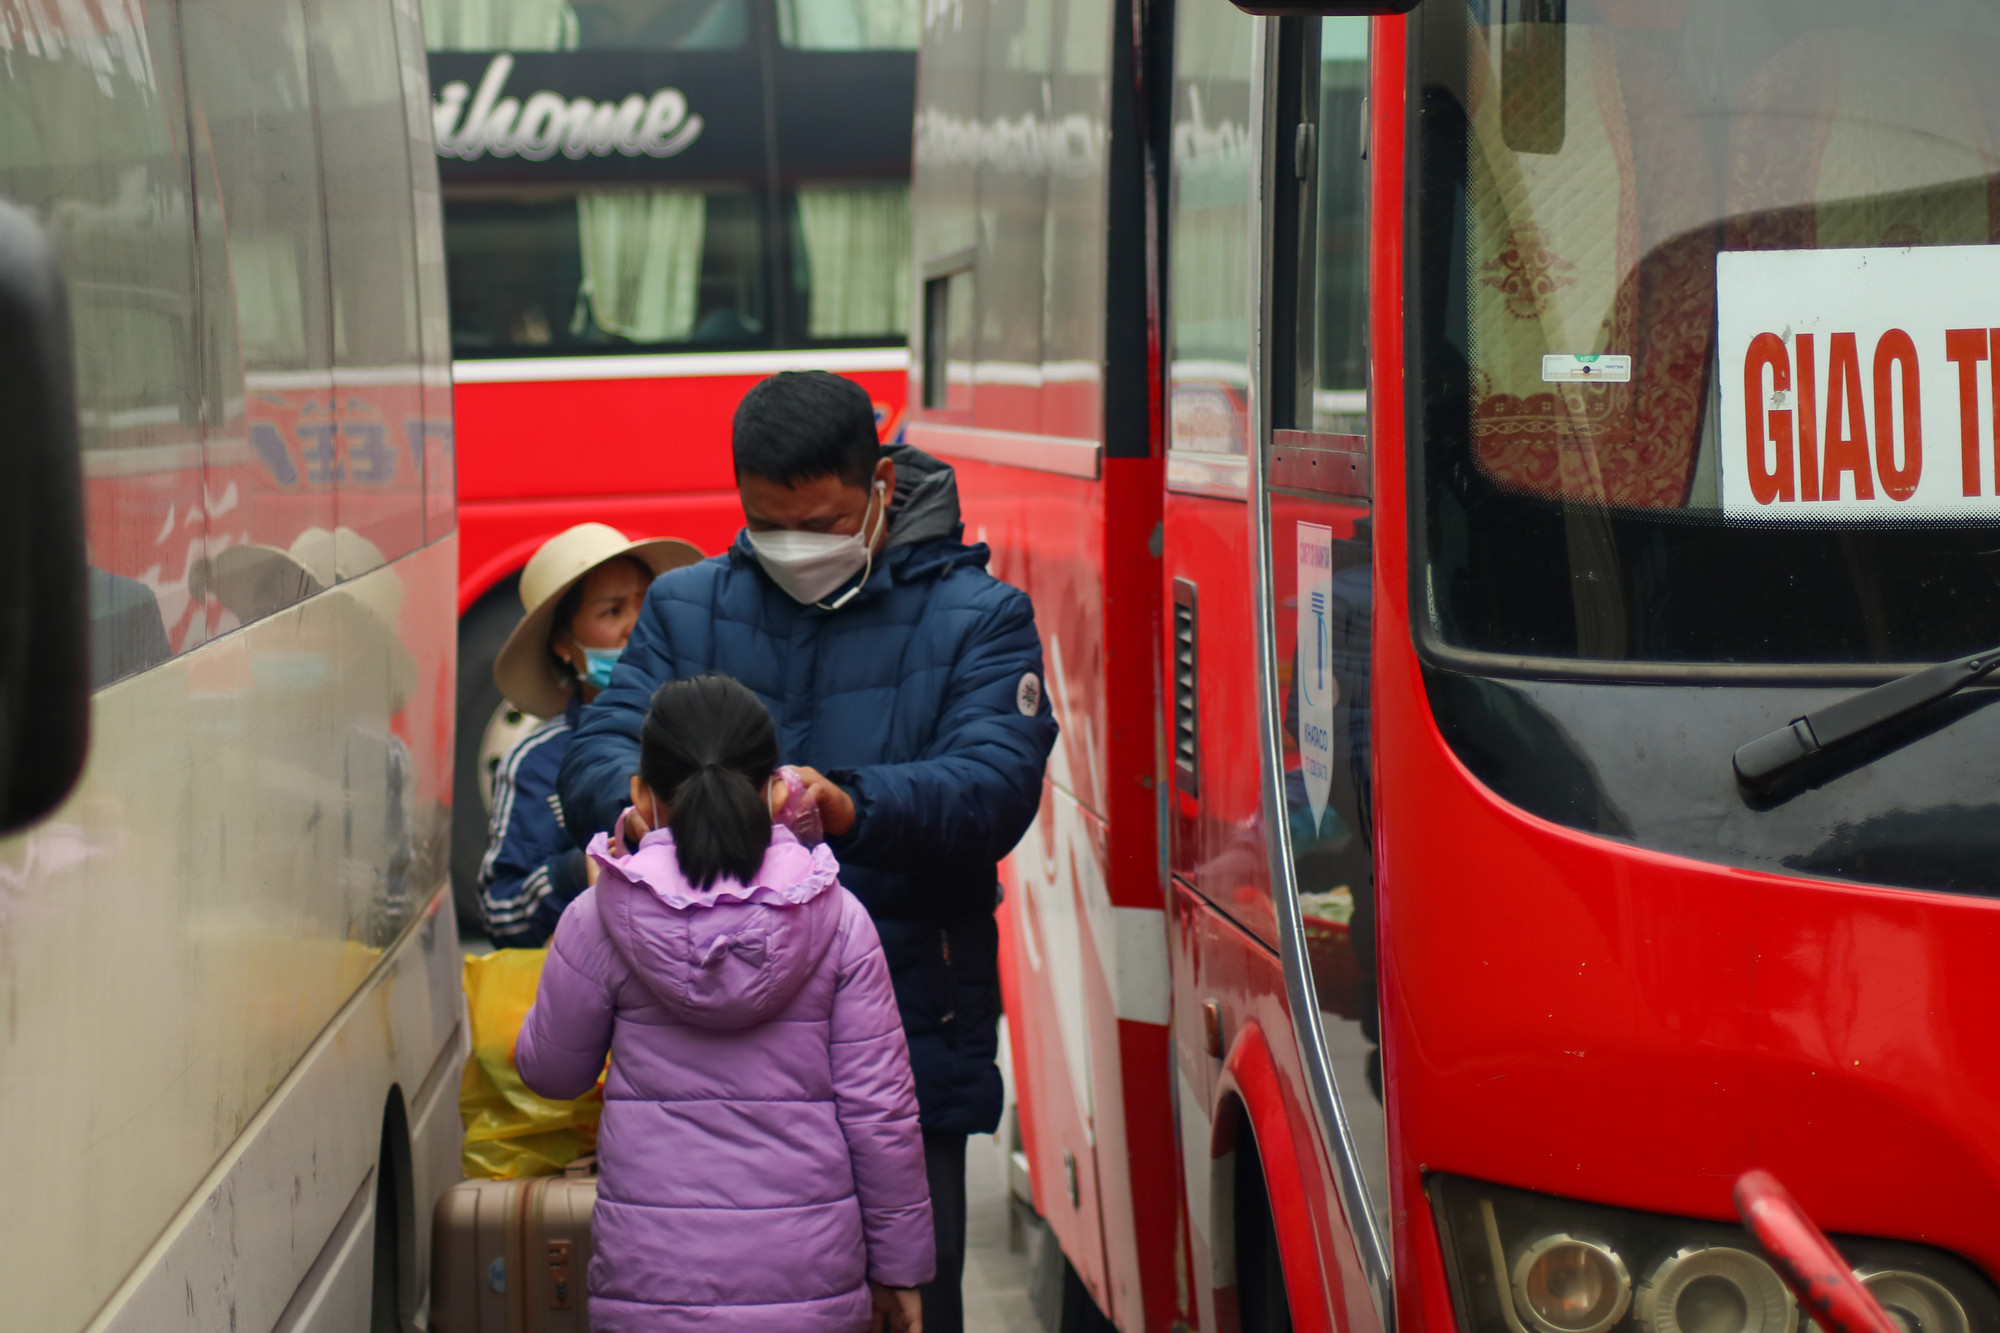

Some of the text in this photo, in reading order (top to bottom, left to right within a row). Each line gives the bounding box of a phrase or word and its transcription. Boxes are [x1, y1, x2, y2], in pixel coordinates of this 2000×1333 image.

[432, 52, 705, 162] ihome
[1744, 328, 2000, 505] GIAO T
